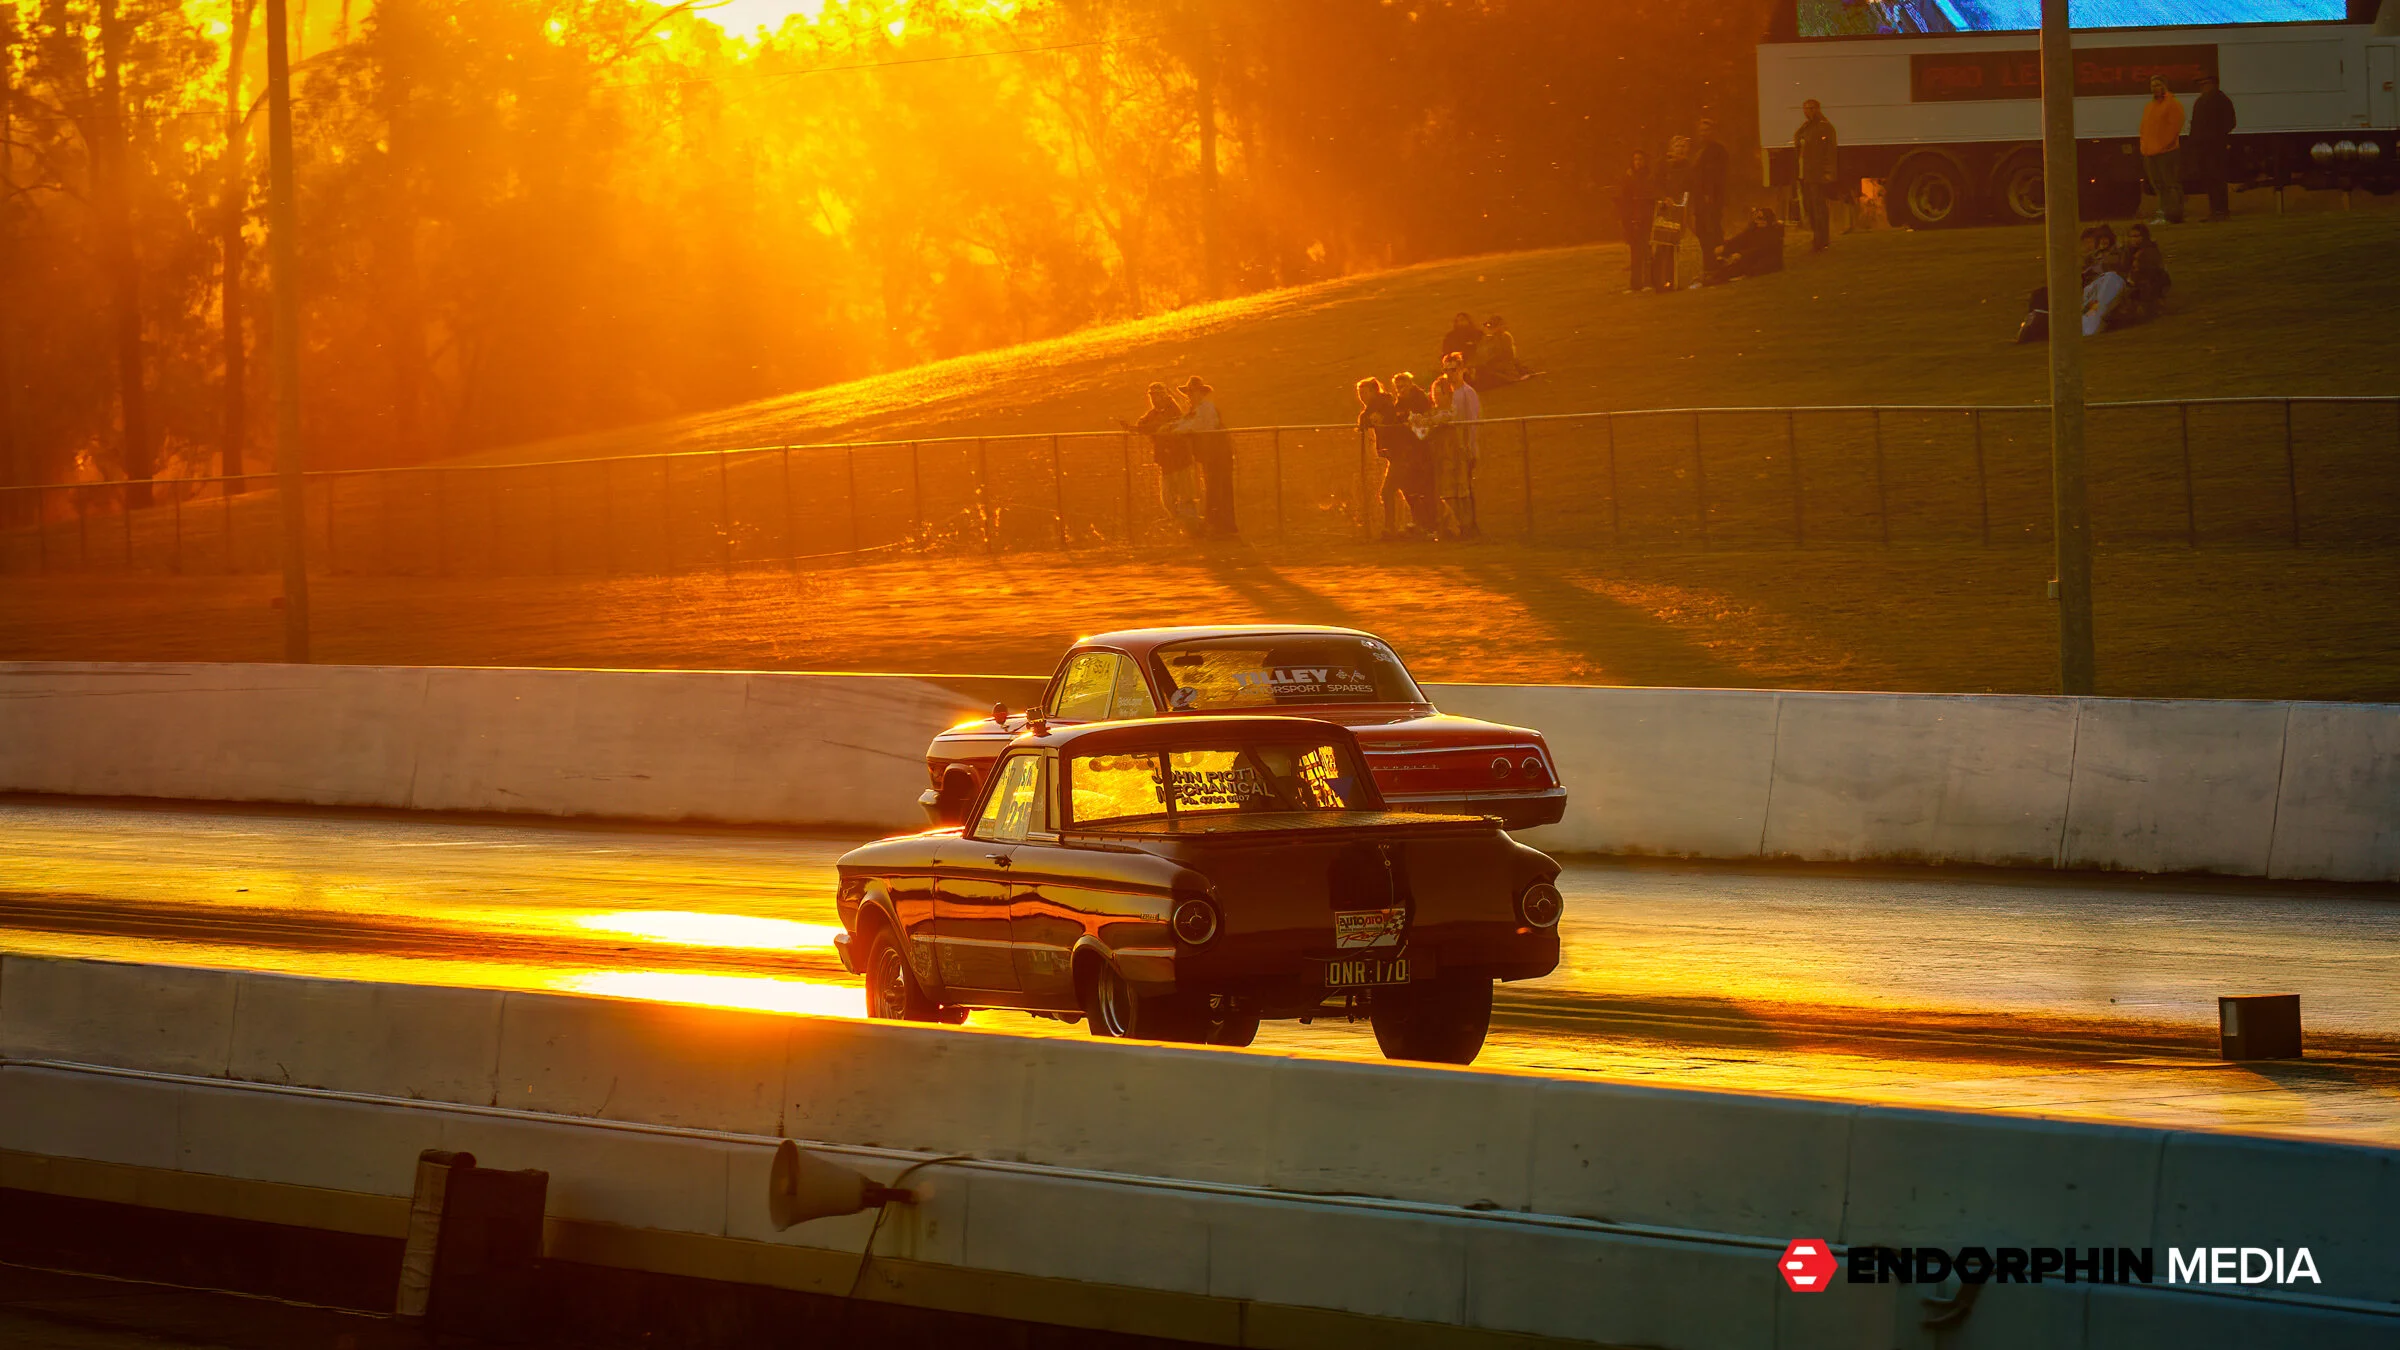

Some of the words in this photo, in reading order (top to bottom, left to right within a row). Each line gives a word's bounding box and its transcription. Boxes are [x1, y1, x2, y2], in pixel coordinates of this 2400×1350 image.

[1231, 668, 1328, 687] TILLEY
[1327, 684, 1374, 694] SPARES
[1151, 767, 1203, 785] JHN
[1155, 781, 1276, 804] MECHANICAL
